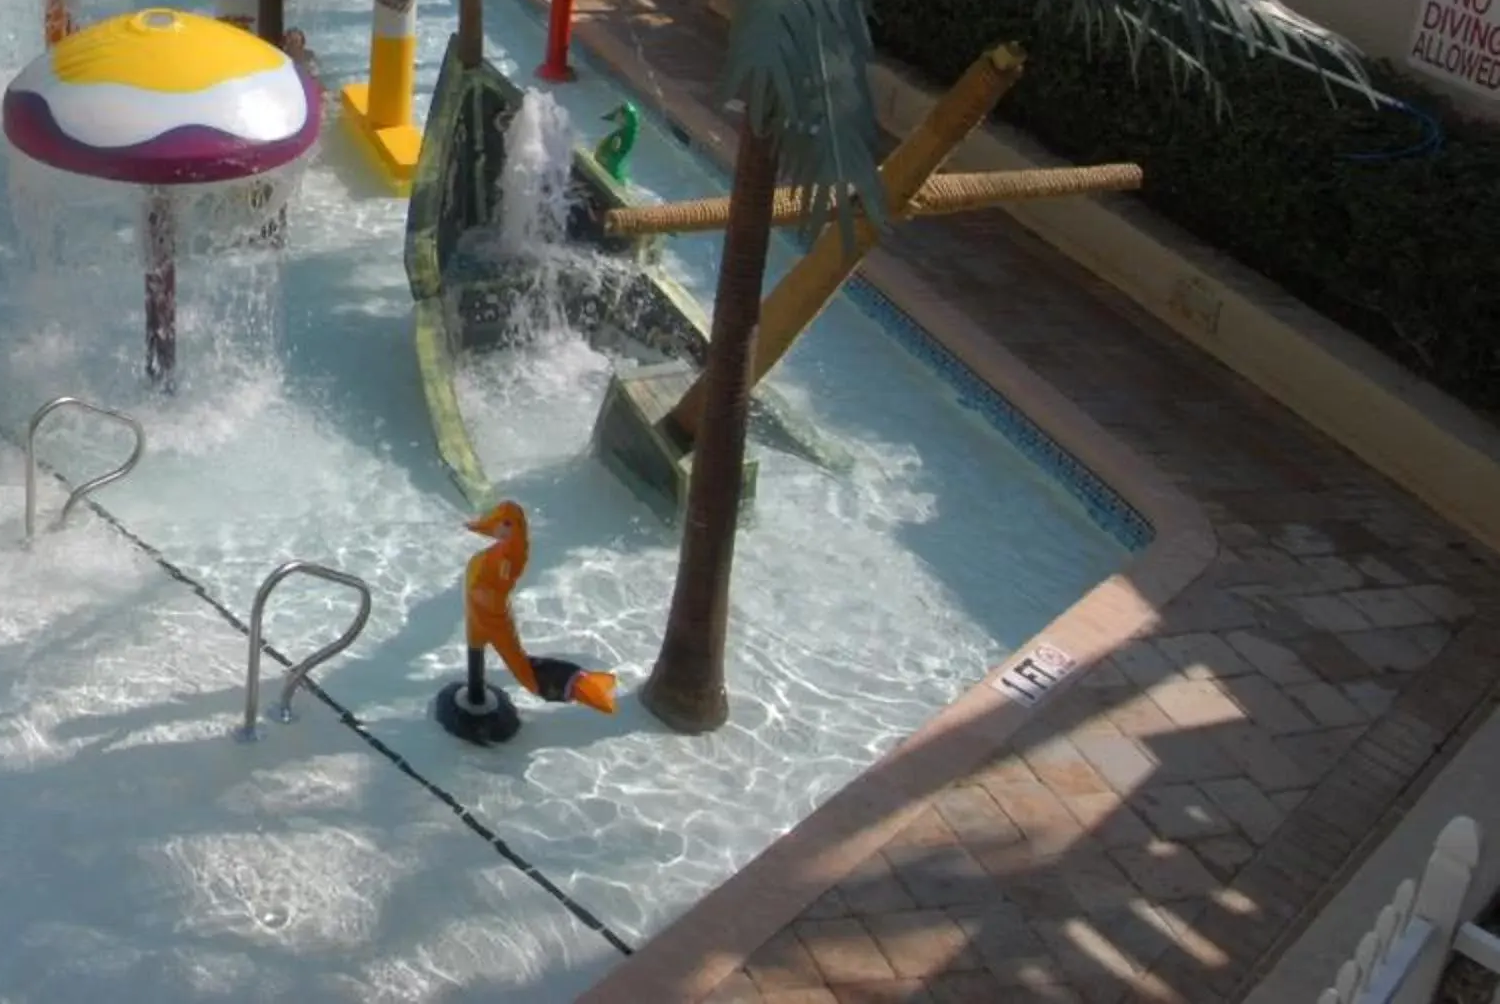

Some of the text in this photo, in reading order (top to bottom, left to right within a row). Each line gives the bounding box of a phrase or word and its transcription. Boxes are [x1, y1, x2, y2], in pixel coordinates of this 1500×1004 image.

[1422, 0, 1500, 56] DIVING
[1411, 31, 1500, 90] ALLOWED
[1001, 677, 1036, 700] 1
[1013, 657, 1057, 690] FT
